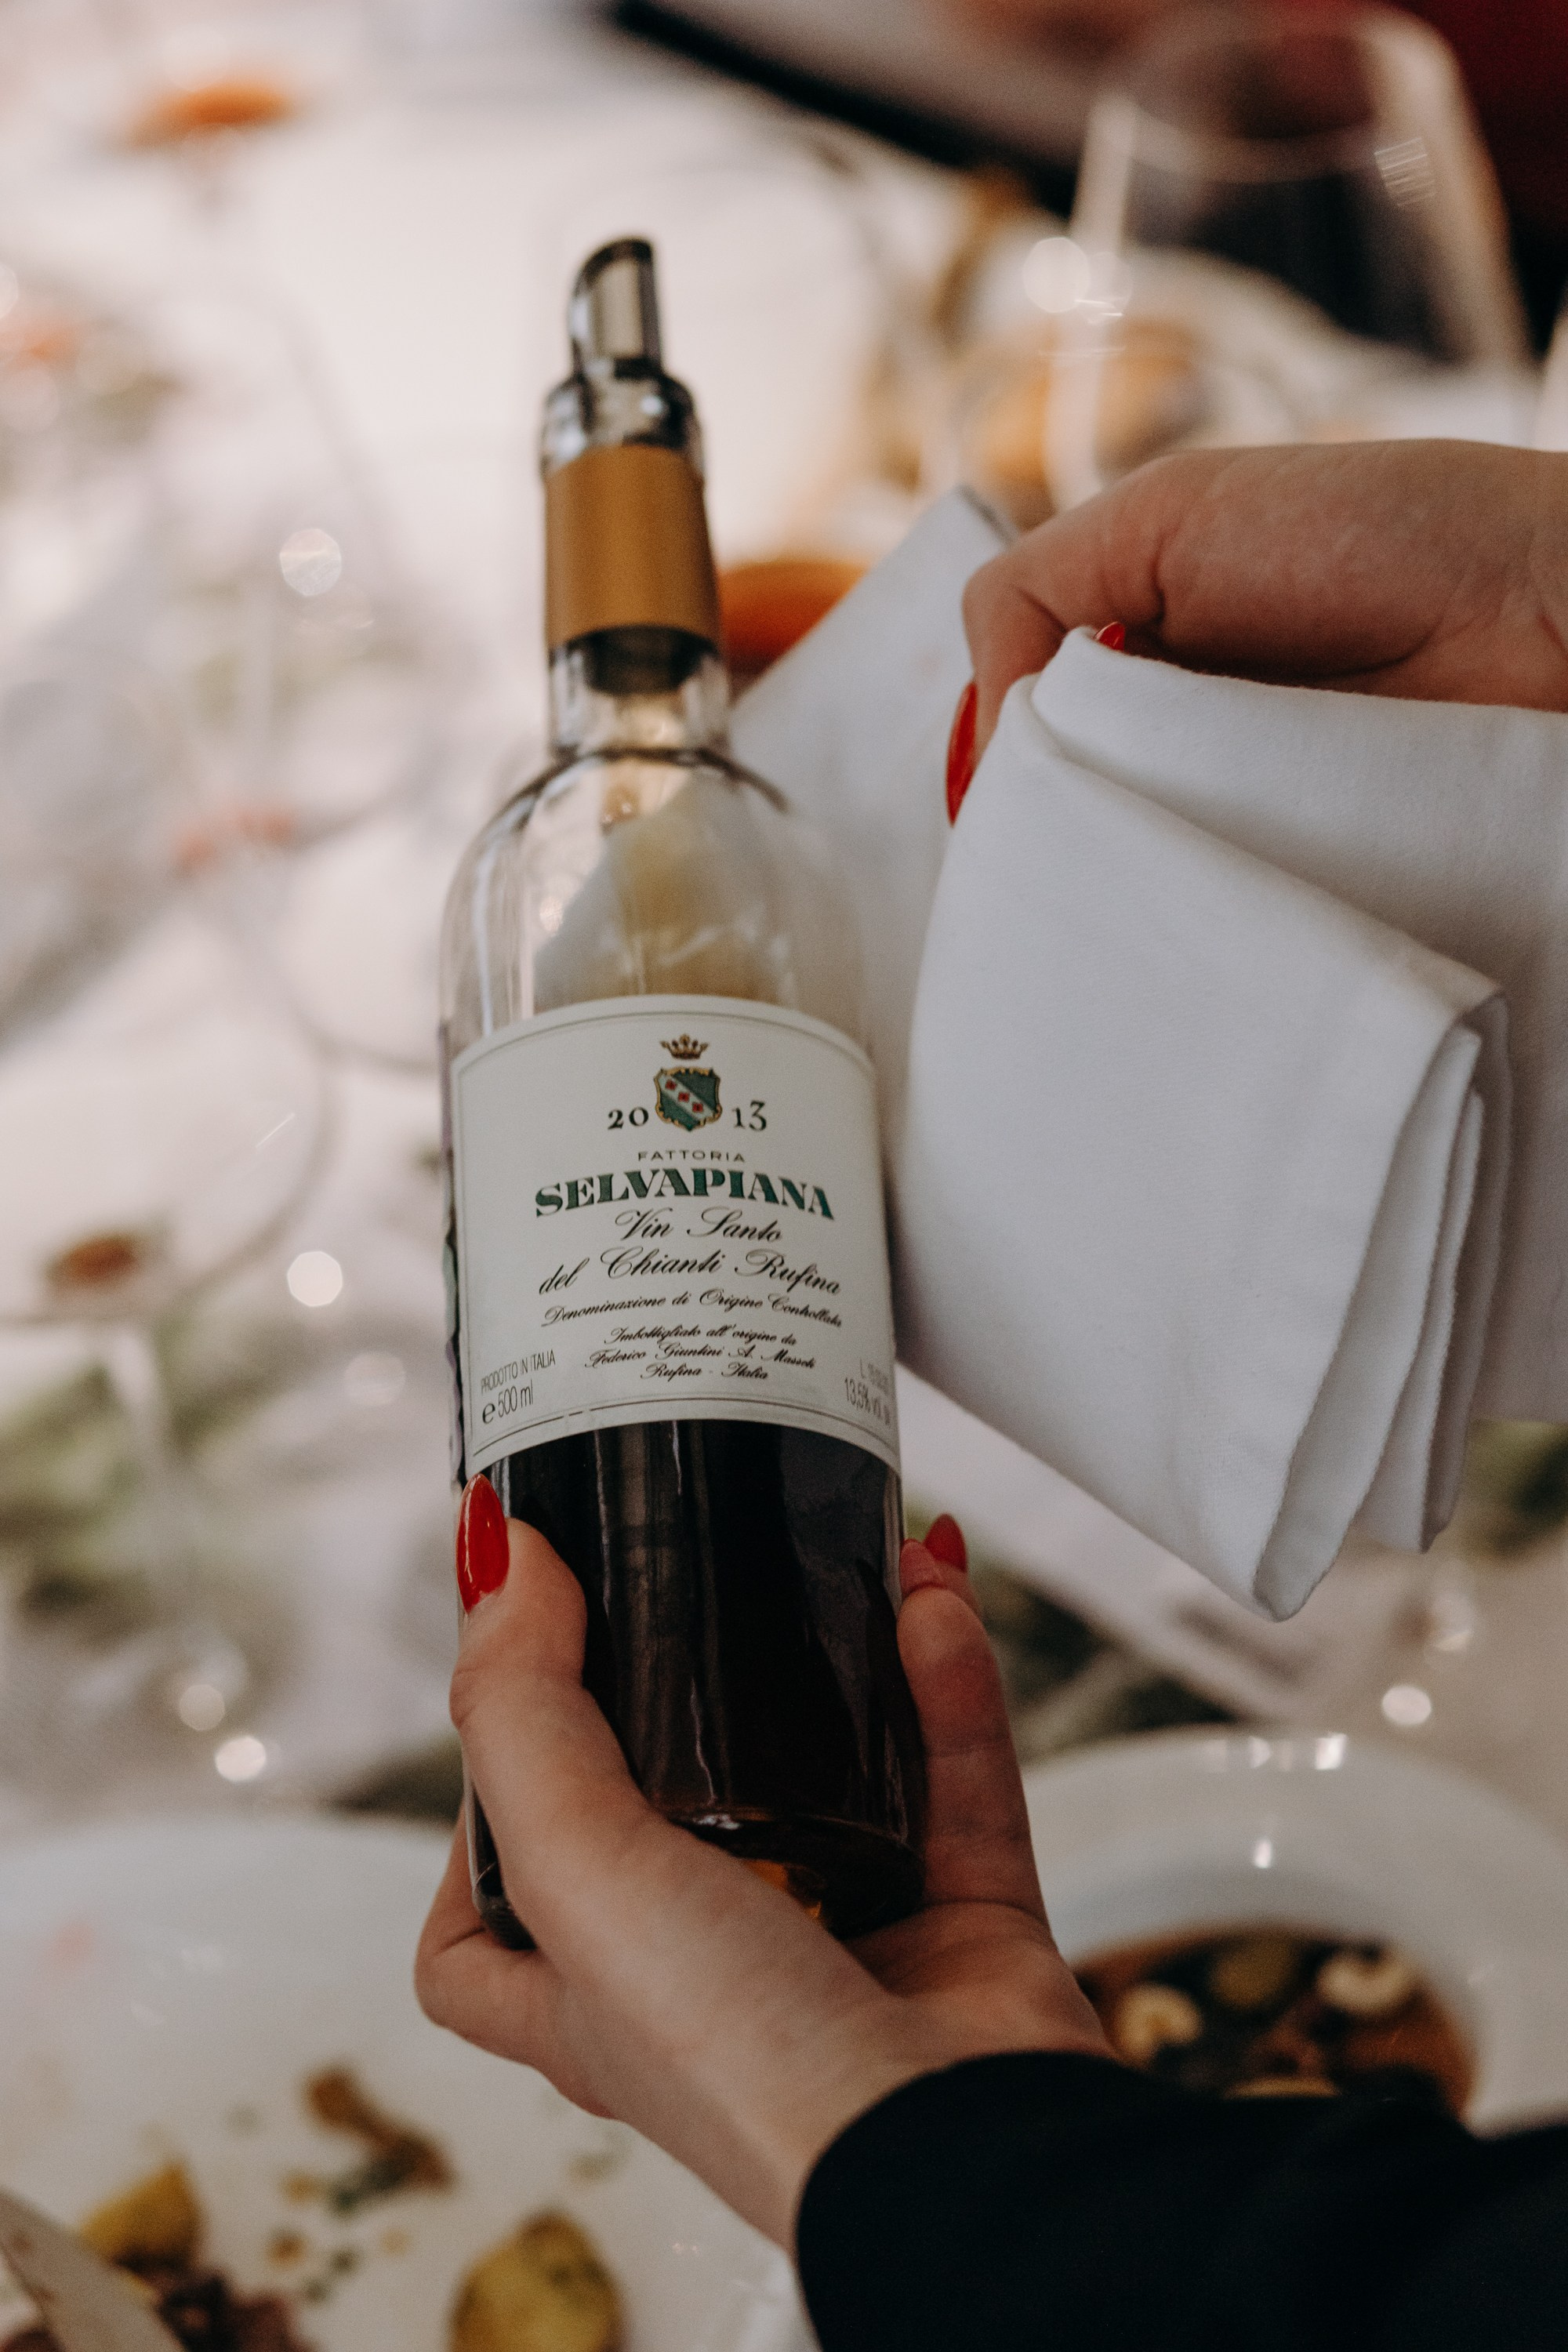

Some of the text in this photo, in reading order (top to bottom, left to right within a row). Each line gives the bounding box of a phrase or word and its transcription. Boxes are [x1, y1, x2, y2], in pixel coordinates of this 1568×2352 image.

[608, 1099, 768, 1131] 20 13
[637, 1149, 746, 1163] FATTORIA
[535, 1167, 835, 1220] SELVAPIANA
[615, 1206, 782, 1243] Vin Santo
[539, 1246, 842, 1295] del Chianti Rufina
[540, 1295, 666, 1327] Denominazione
[671, 1290, 691, 1305] di
[699, 1287, 763, 1313] Origine
[481, 1360, 518, 1396] PRODOTTO
[530, 1348, 556, 1372] ITALIA
[584, 1348, 647, 1369] Federico
[640, 1362, 702, 1382] Rufina
[721, 1361, 768, 1380] Italia
[498, 1385, 517, 1418] 500
[520, 1377, 534, 1409] ml
